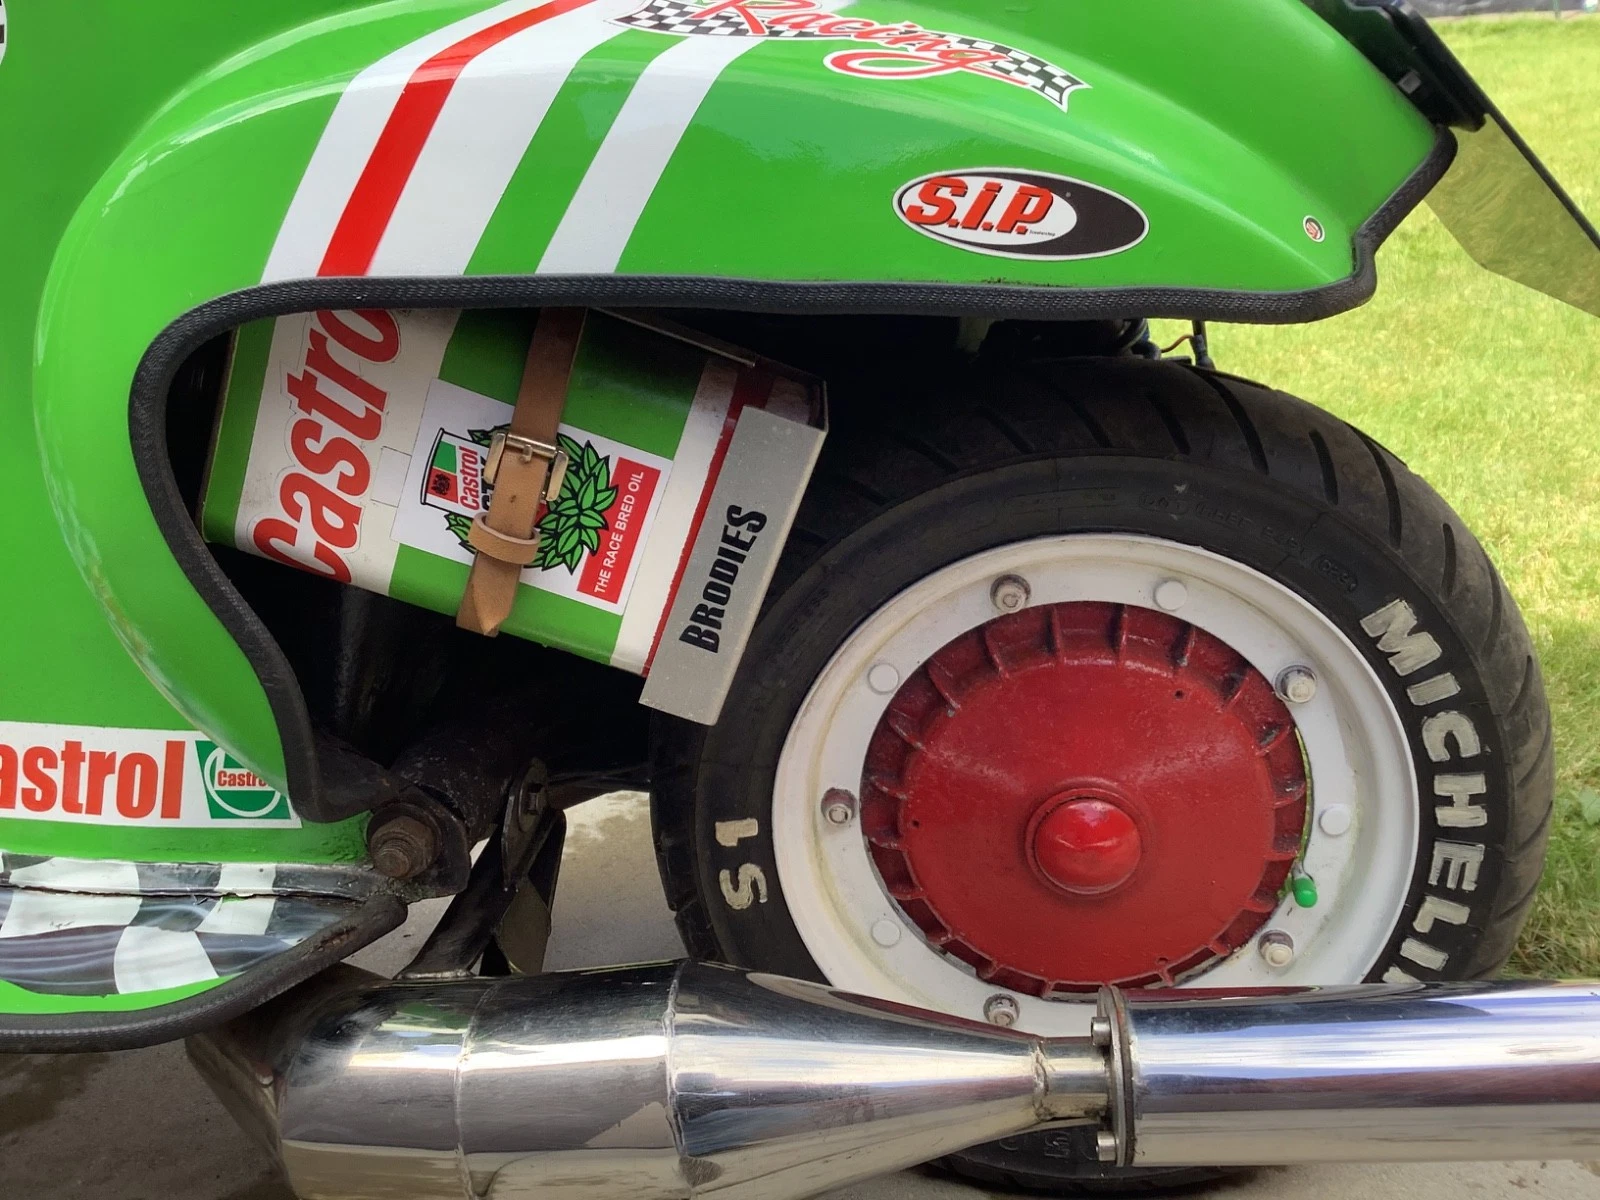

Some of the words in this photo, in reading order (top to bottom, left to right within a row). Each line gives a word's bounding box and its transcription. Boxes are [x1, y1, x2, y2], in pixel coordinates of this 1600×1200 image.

[689, 0, 1030, 86] Racing
[458, 445, 480, 511] Castrol
[628, 471, 644, 492] OIL
[614, 494, 635, 531] BRED
[602, 532, 623, 568] RACE
[594, 569, 612, 593] THE
[679, 504, 768, 654] BRODIES
[1360, 599, 1488, 983] MICHELI
